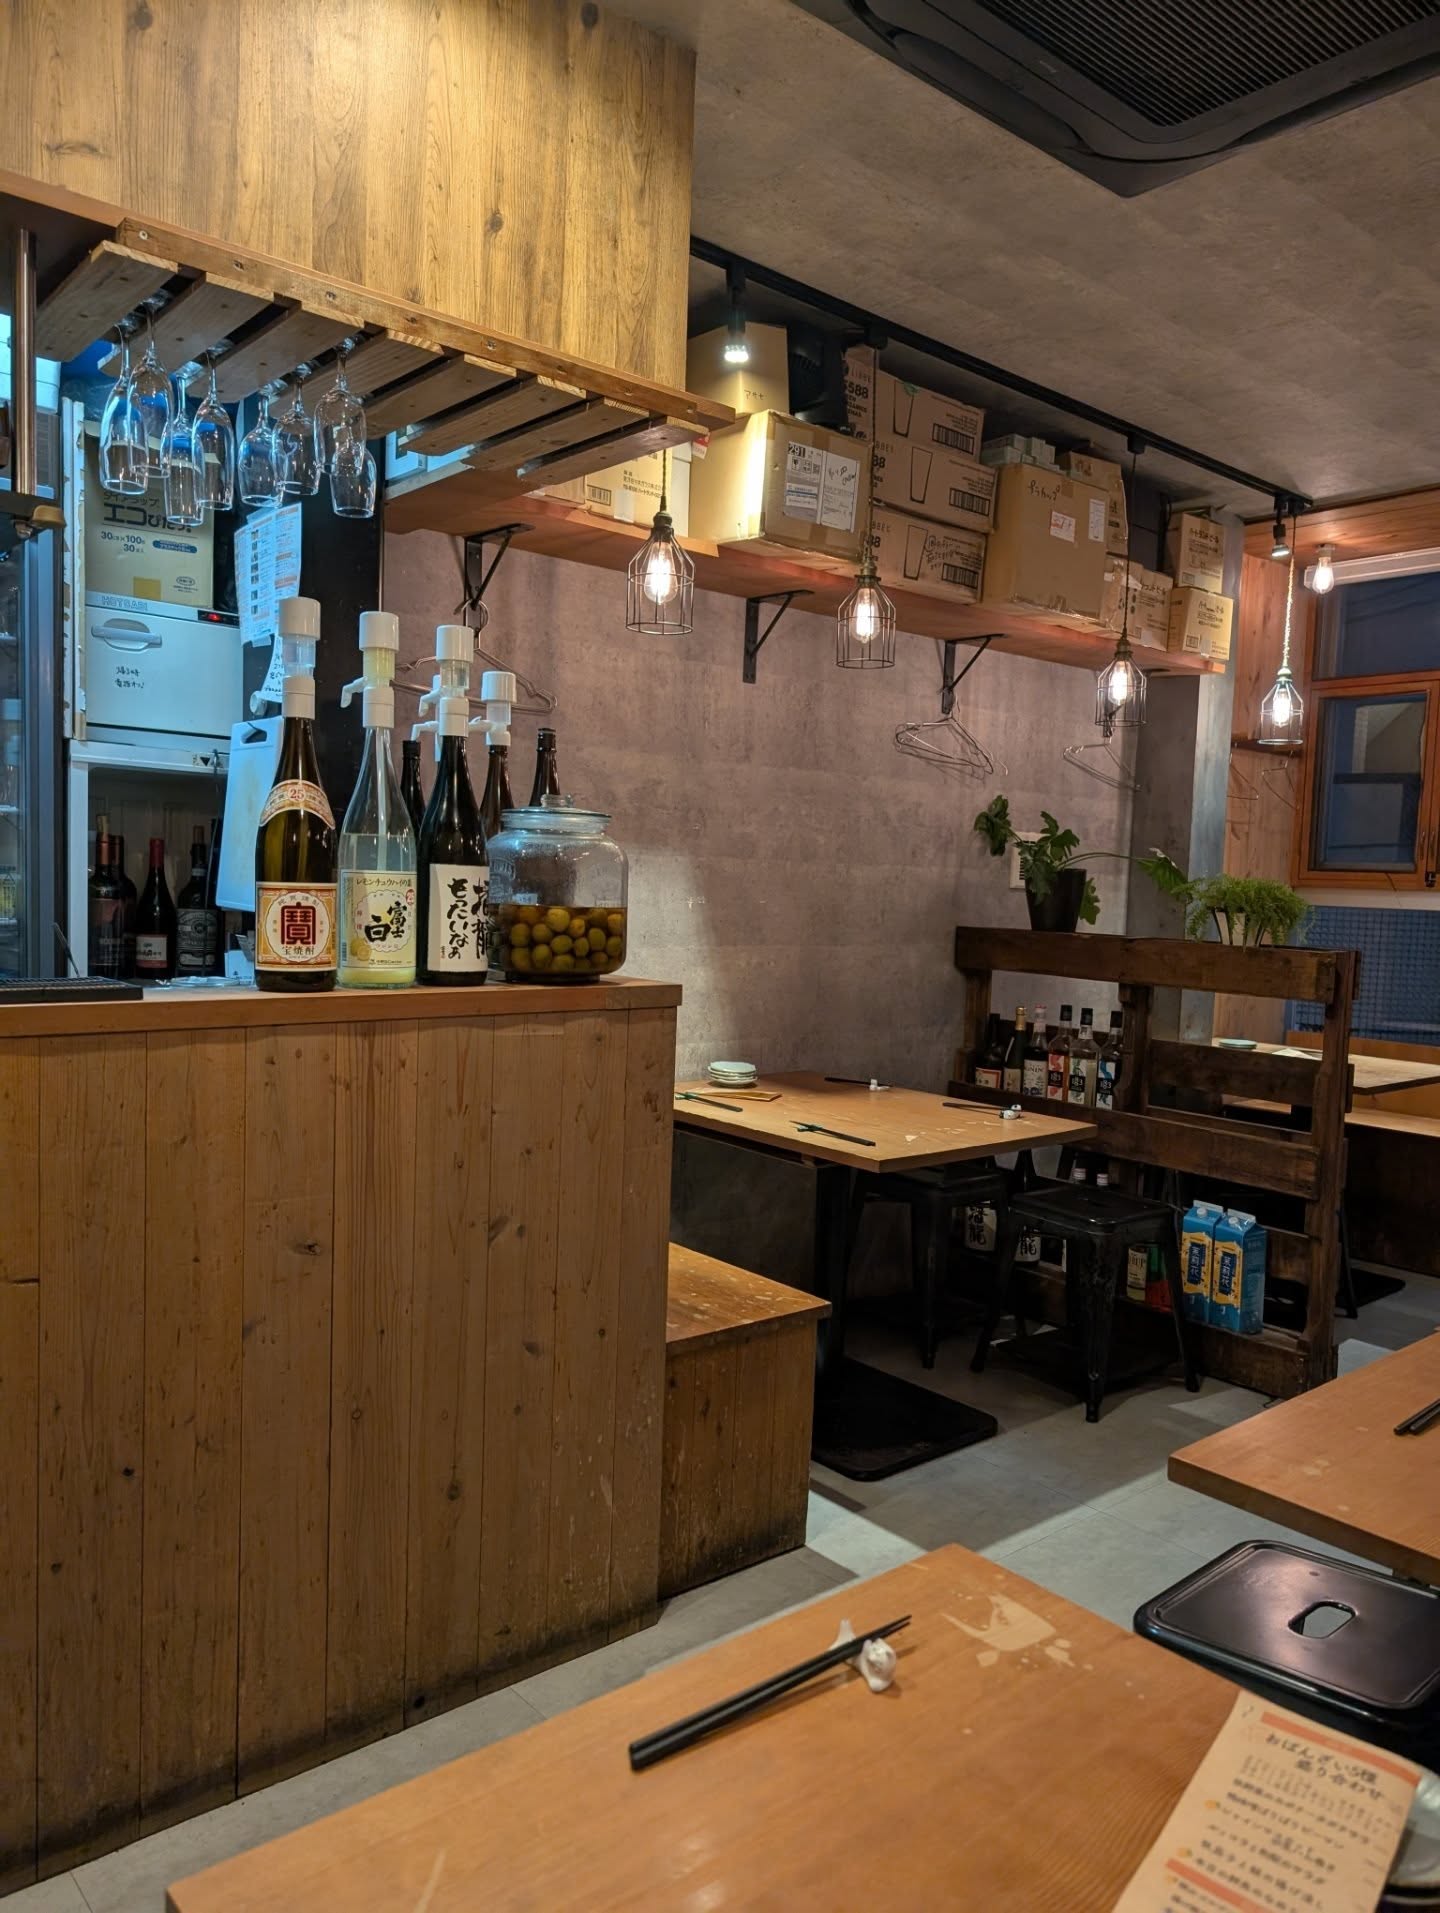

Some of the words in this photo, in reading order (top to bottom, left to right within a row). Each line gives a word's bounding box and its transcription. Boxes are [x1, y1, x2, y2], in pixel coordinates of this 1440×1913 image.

[290, 788, 305, 800] 25
[281, 945, 315, 956] 宝焼酎
